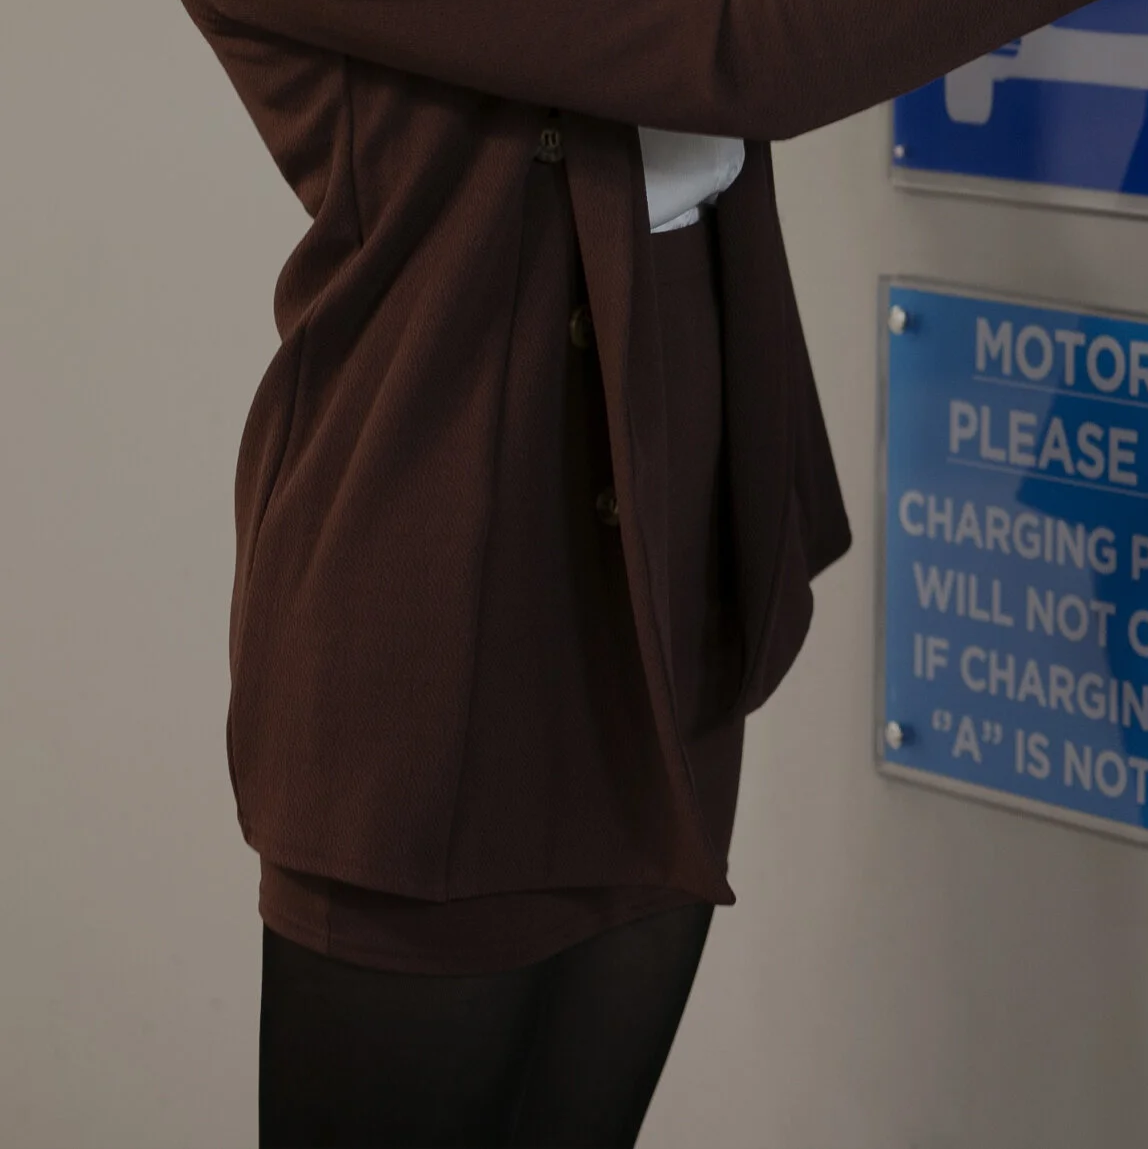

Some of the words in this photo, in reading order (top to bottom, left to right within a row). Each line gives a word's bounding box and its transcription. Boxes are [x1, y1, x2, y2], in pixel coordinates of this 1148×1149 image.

[950, 401, 1138, 486] PLEASE
[900, 490, 1116, 574] CHARGING
[913, 563, 1013, 627] WILL
[1027, 588, 1116, 642] NOT
[914, 634, 949, 680] IF
[1016, 733, 1051, 780] IS
